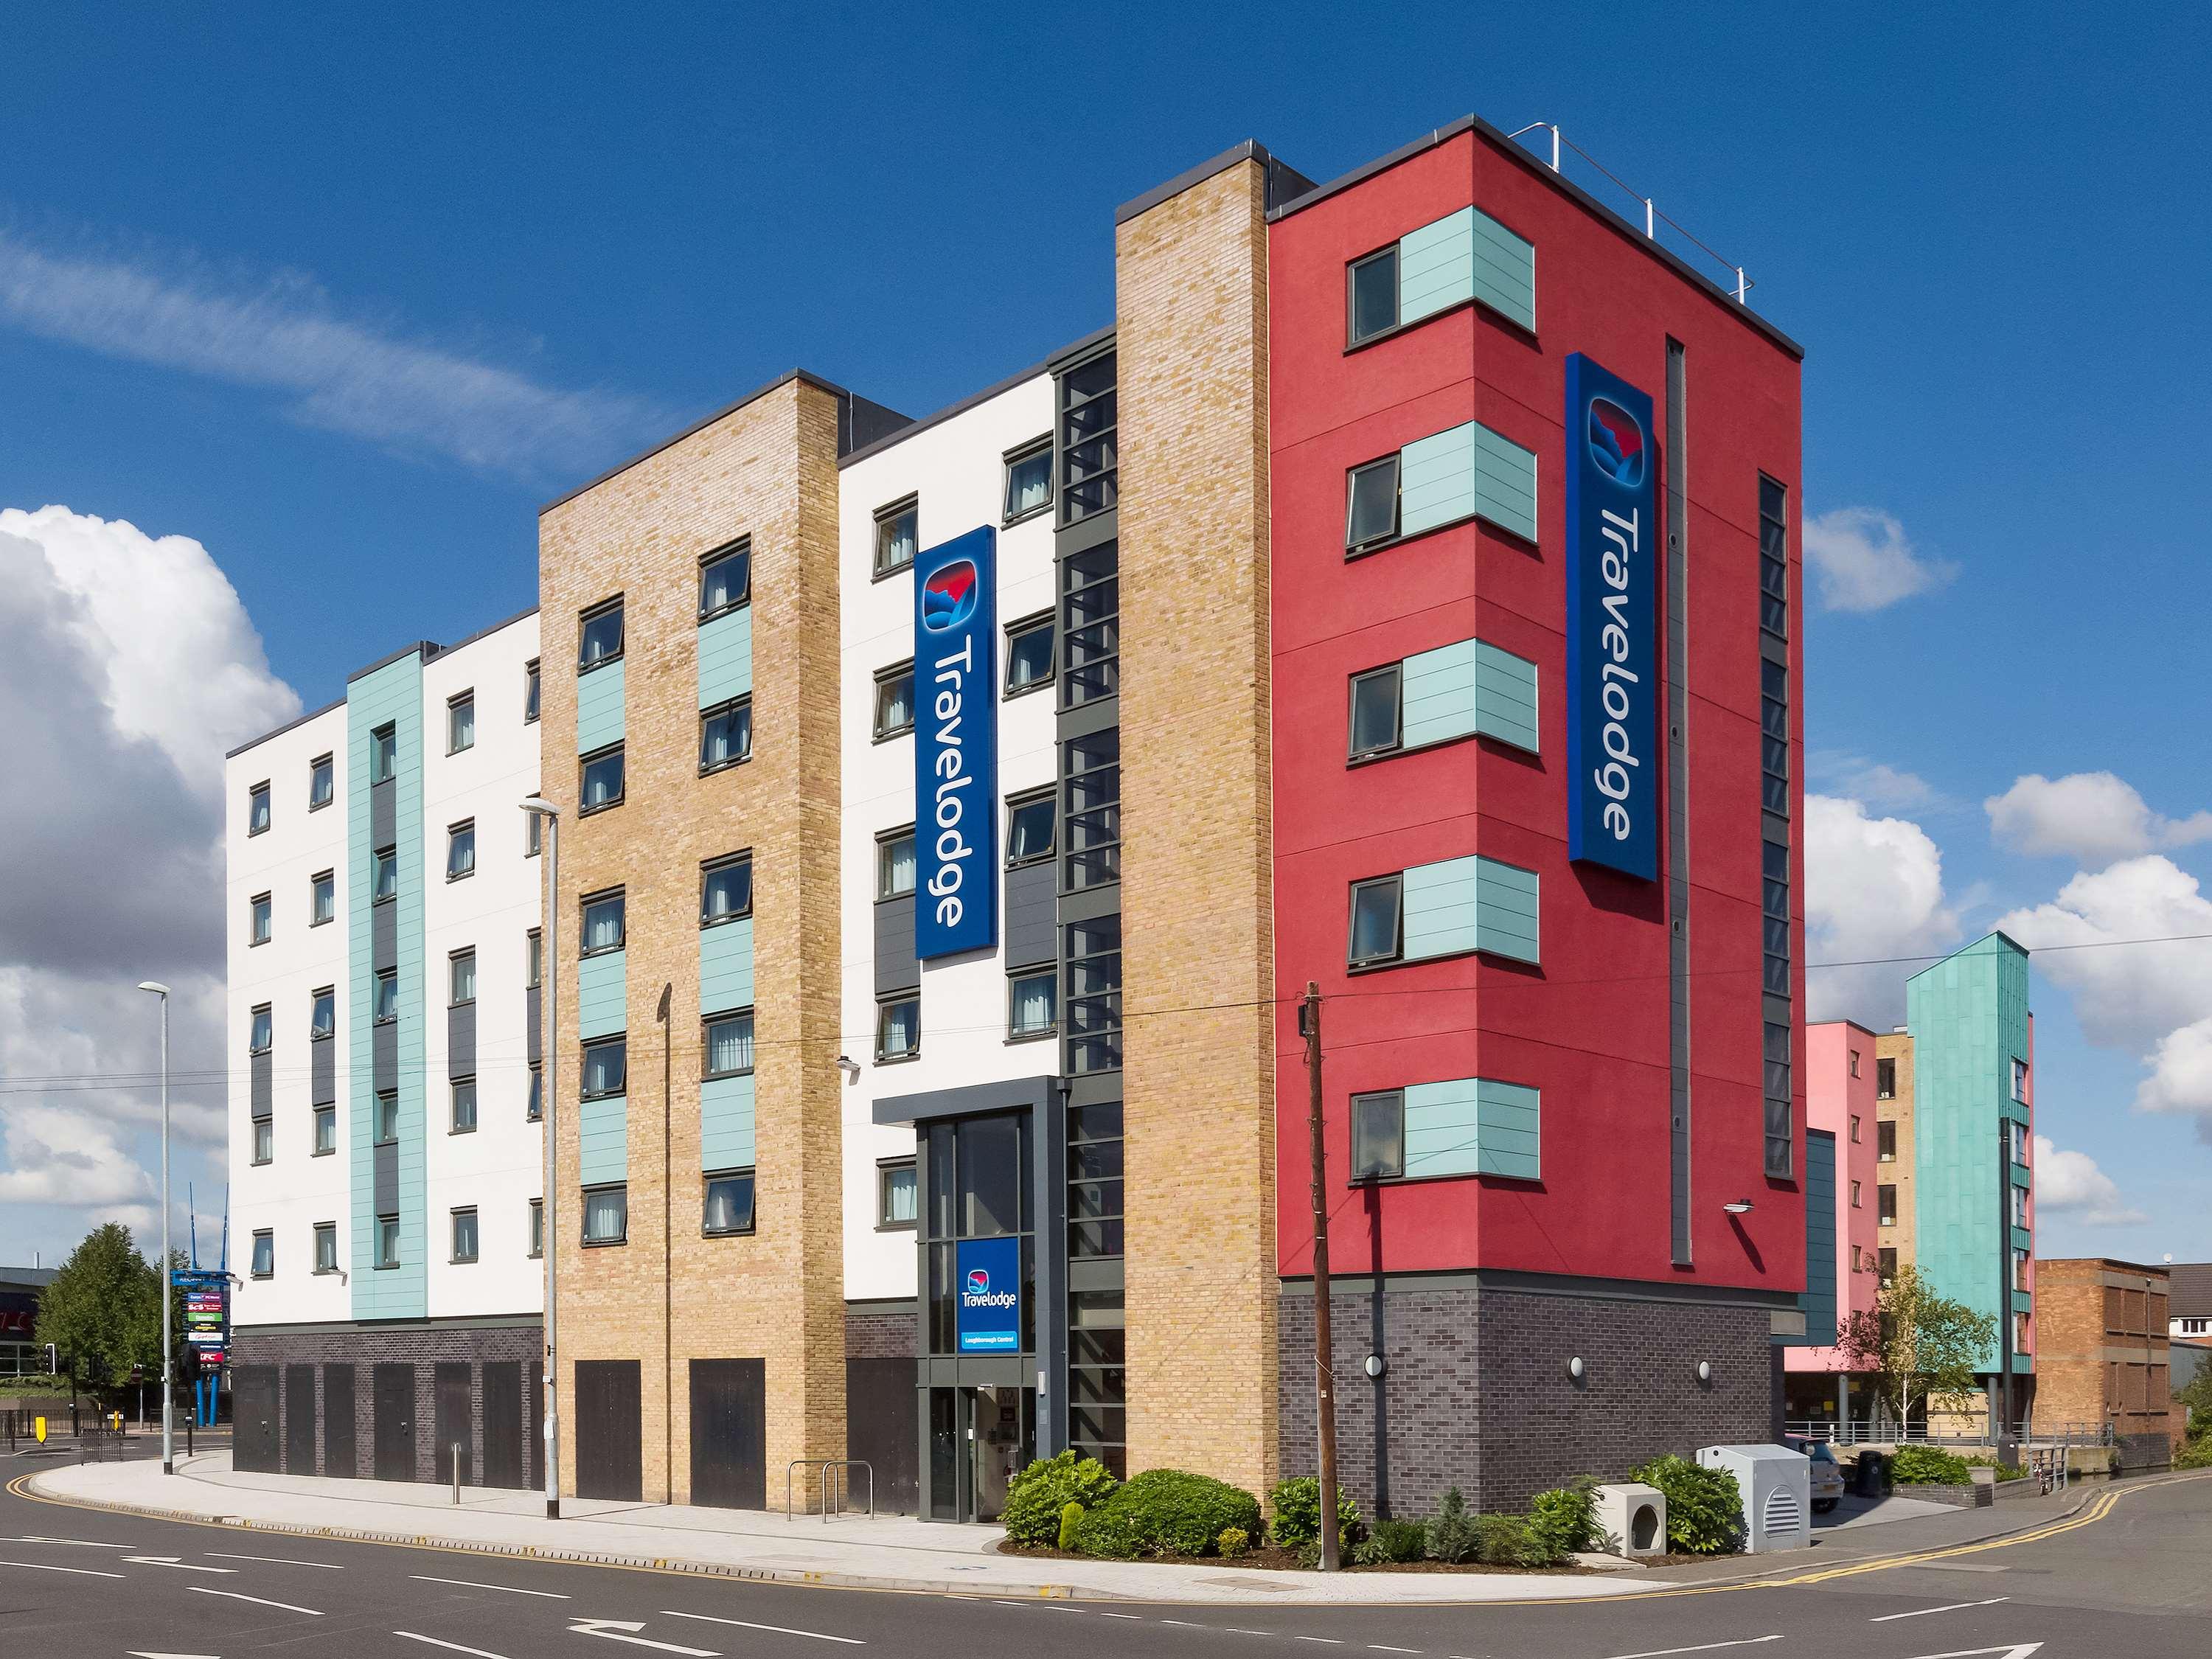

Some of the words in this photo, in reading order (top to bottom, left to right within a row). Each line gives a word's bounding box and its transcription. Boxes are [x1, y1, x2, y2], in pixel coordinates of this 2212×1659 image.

[928, 634, 972, 928] Travelodge
[1594, 507, 1639, 841] Travelodge
[961, 1290, 1016, 1309] Travelodge
